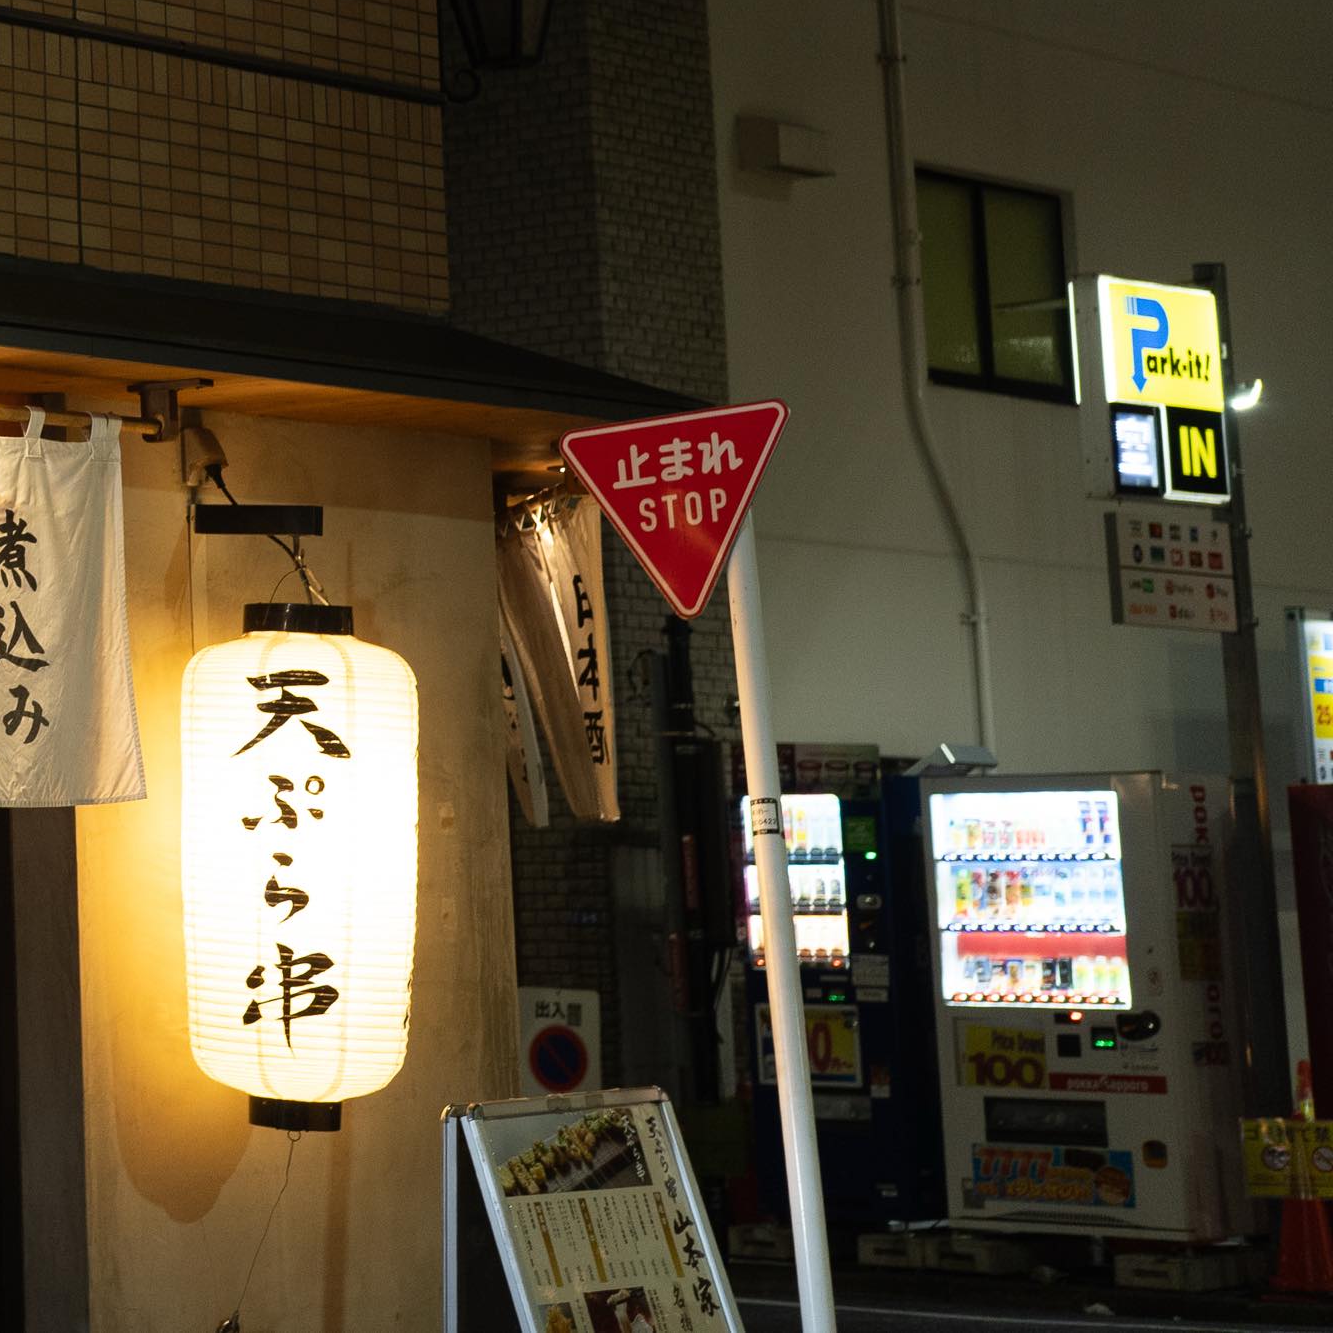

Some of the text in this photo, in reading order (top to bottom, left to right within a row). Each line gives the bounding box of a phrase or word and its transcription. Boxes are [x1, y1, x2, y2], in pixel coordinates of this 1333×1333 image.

[1125, 295, 1211, 394] Park-it!
[613, 431, 743, 491] 止まれ
[1179, 425, 1217, 479] IN
[638, 487, 728, 532] STOP
[232, 670, 351, 1058] 天ぷら串
[673, 1210, 721, 1317] 山本家
